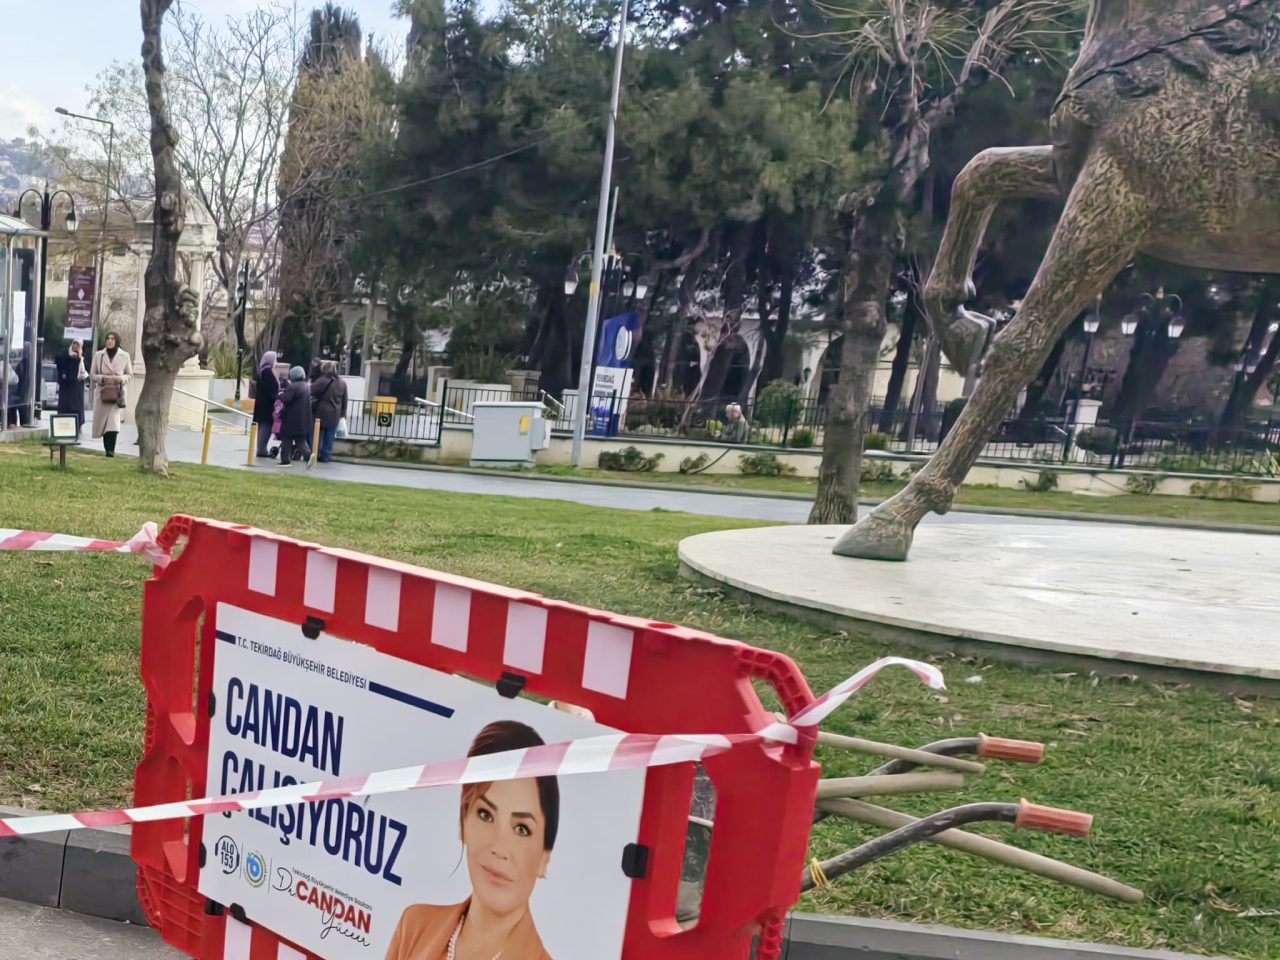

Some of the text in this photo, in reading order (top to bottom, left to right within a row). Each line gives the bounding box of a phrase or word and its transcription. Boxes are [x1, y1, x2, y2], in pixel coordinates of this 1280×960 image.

[237, 636, 249, 650] T.C.
[250, 640, 282, 660] TEKİRDAĞ
[283, 650, 325, 675] BÜYÜKŞEHİR
[225, 677, 344, 778] CANDAN
[220, 750, 407, 886] ÇALIŞIYORUZ
[221, 840, 234, 855] ALO
[221, 851, 234, 869] 153
[295, 880, 372, 934] CANDAN
